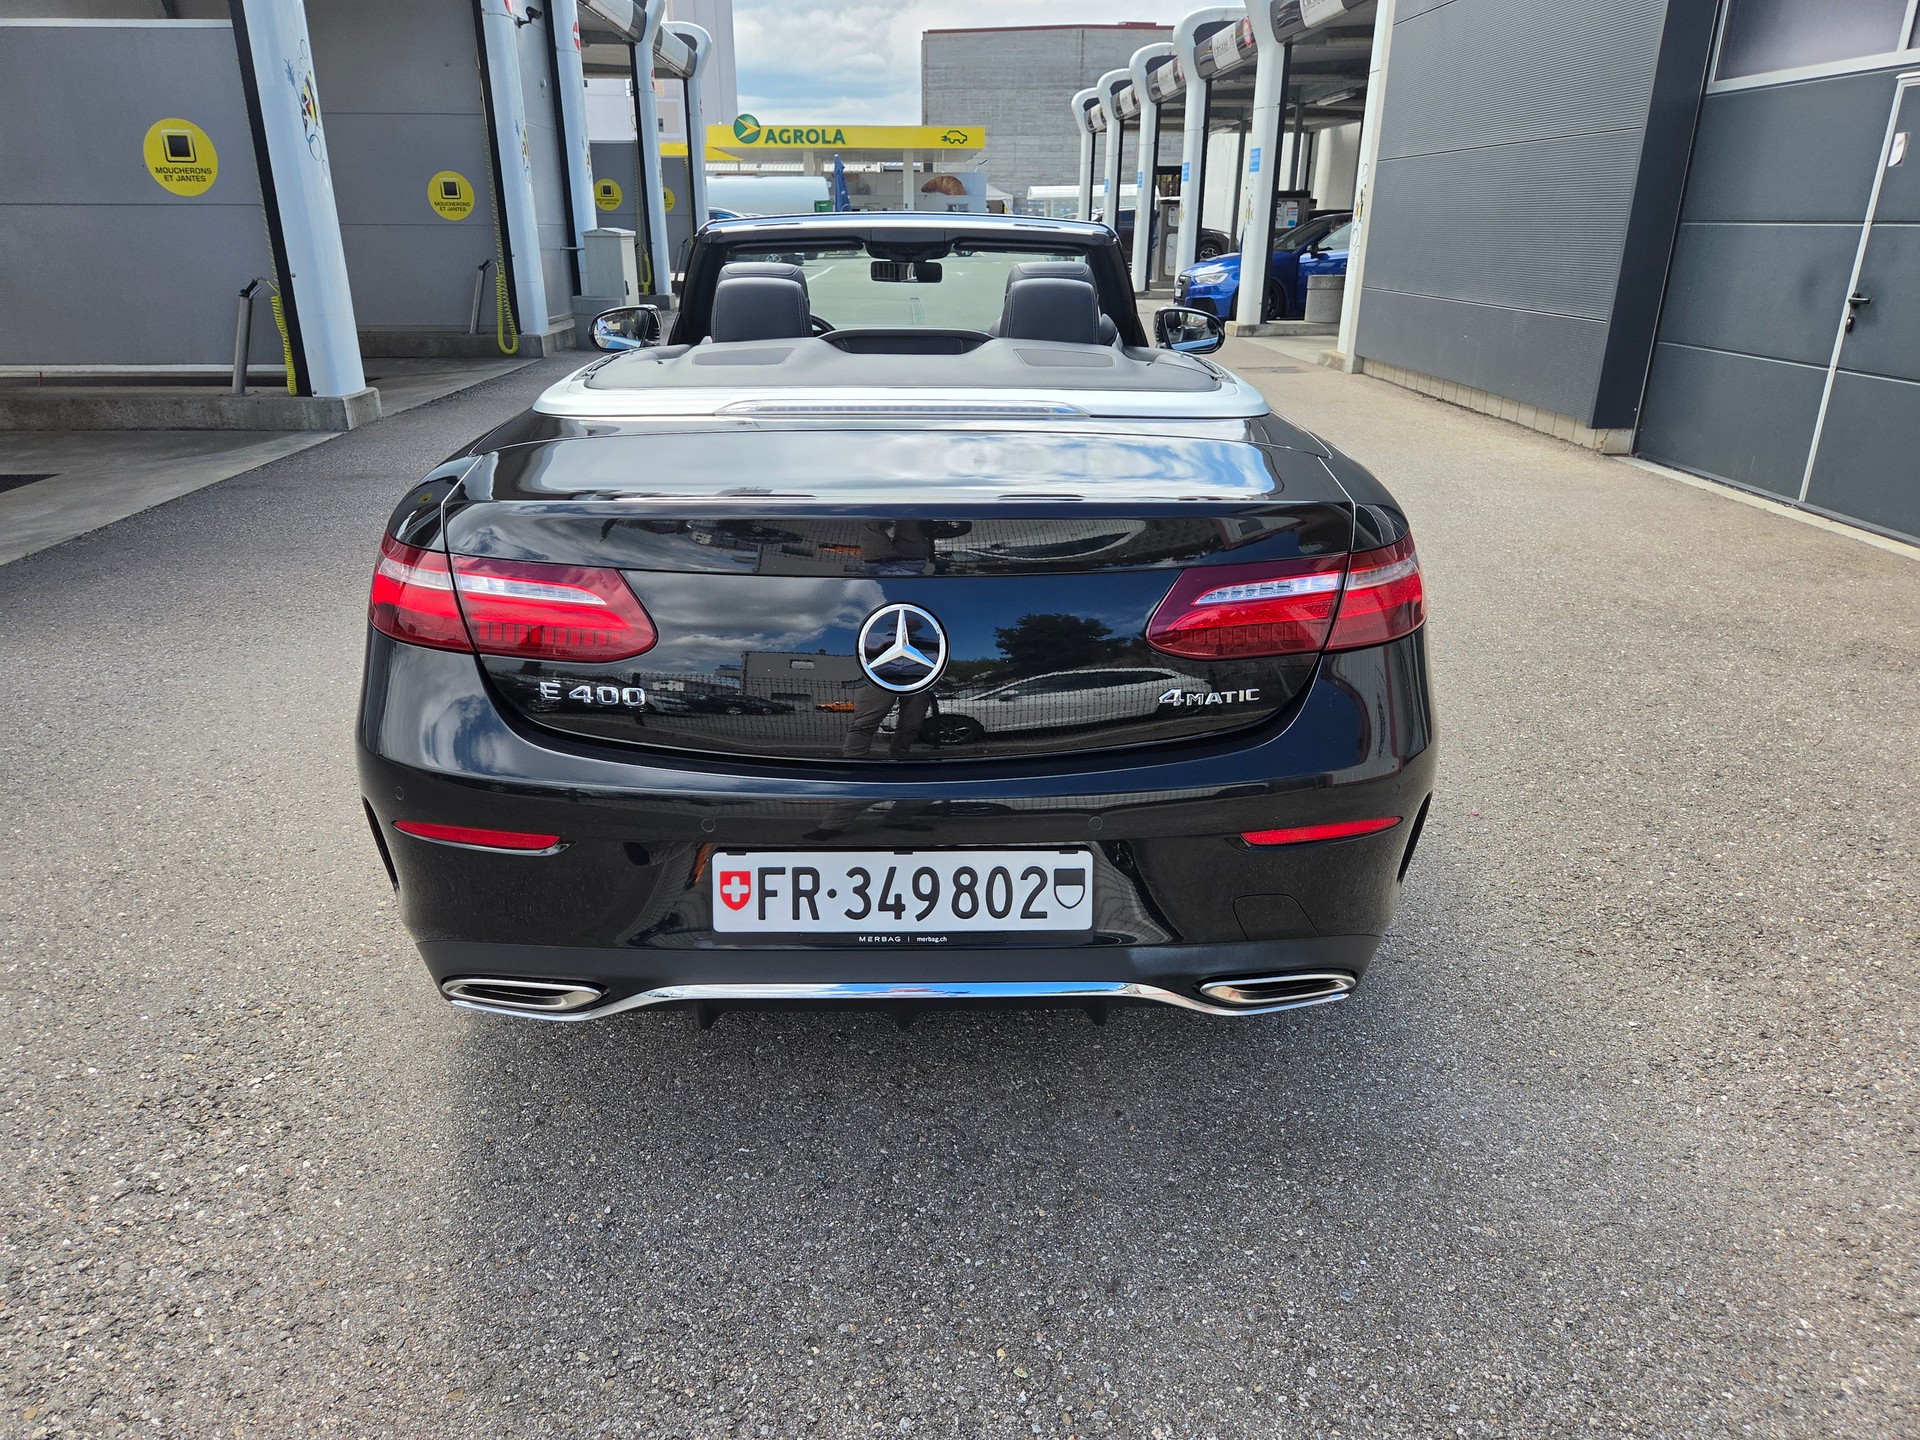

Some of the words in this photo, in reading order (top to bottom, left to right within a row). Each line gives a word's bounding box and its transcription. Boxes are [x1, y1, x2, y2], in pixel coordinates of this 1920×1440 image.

[764, 128, 846, 145] AGROLA
[155, 166, 212, 175] MOUCHERONS
[164, 174, 173, 182] ET
[176, 174, 207, 183] JANTES
[539, 681, 562, 700] E
[568, 685, 646, 706] 400
[1158, 688, 1260, 706] 4MATIC
[916, 935, 948, 943] merbag.ch
